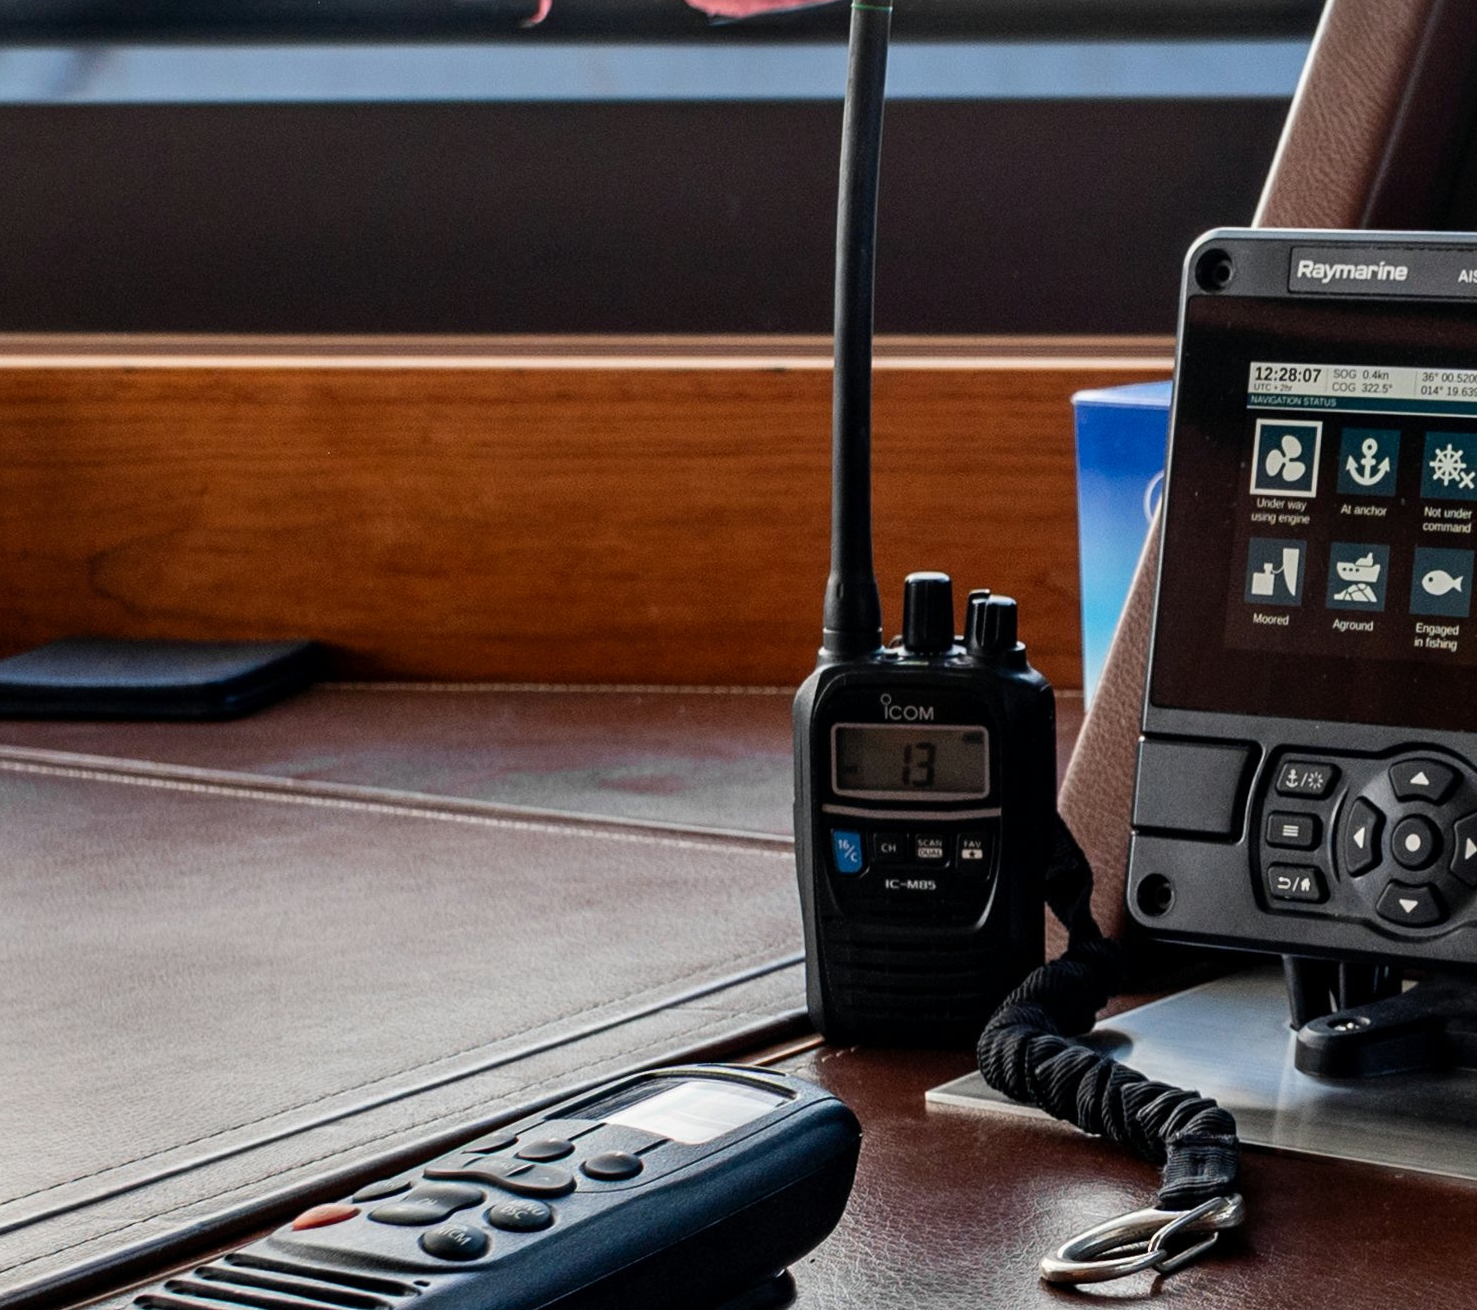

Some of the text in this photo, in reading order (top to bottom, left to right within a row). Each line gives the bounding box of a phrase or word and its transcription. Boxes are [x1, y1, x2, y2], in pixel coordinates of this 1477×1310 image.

[1297, 260, 1409, 284] Raymarine
[1254, 366, 1322, 384] 12:28:07
[1333, 368, 1390, 380] SOG 0.4kn
[1422, 372, 1439, 383] 36°
[1254, 383, 1272, 392] UTC
[1332, 382, 1357, 393] COG
[1421, 385, 1444, 396] 014°
[1250, 395, 1337, 408] NAVIGATION STATUS
[1257, 497, 1307, 512] Under way
[1340, 504, 1387, 517] At anchor
[1251, 513, 1311, 526] using engine
[1424, 506, 1472, 520] Not under
[1423, 521, 1472, 534] command
[1252, 612, 1290, 626] Moored
[1332, 618, 1374, 633] Aground
[1415, 622, 1460, 637] Engaged
[1413, 636, 1458, 653] in fishing
[902, 742, 936, 787] 13
[881, 842, 897, 854] CH
[963, 839, 982, 850] FAV
[885, 878, 937, 892] IC-M85
